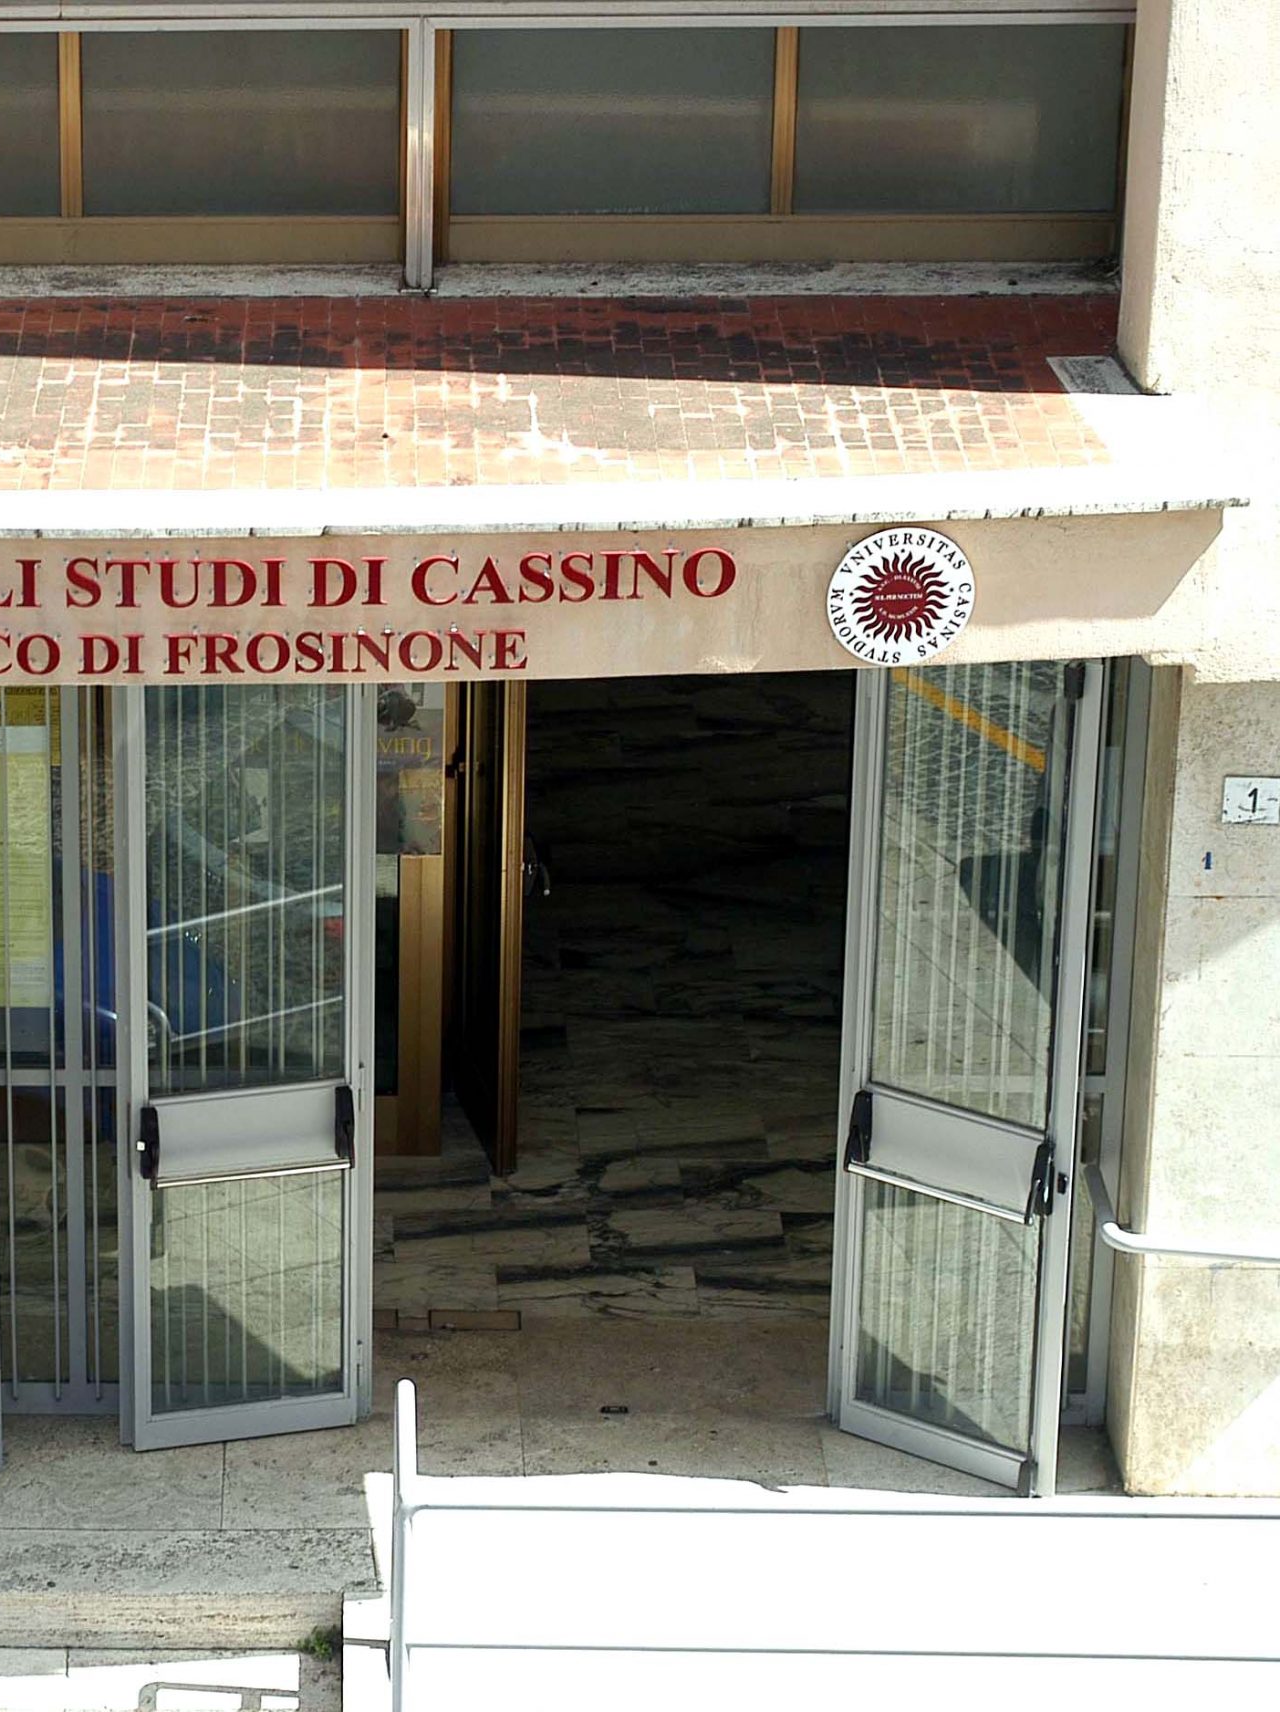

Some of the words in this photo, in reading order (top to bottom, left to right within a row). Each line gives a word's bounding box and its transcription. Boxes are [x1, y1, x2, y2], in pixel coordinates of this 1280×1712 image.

[65, 556, 288, 609] STUDI
[306, 556, 388, 608] DI
[412, 547, 736, 607] CASSINO
[840, 533, 966, 574] VNIVERSITAS
[830, 588, 901, 664] STVDIORVM
[917, 582, 972, 657] CASINAS
[77, 633, 145, 675] DI
[163, 628, 528, 675] FROSINONE
[1248, 787, 1258, 814] 1
